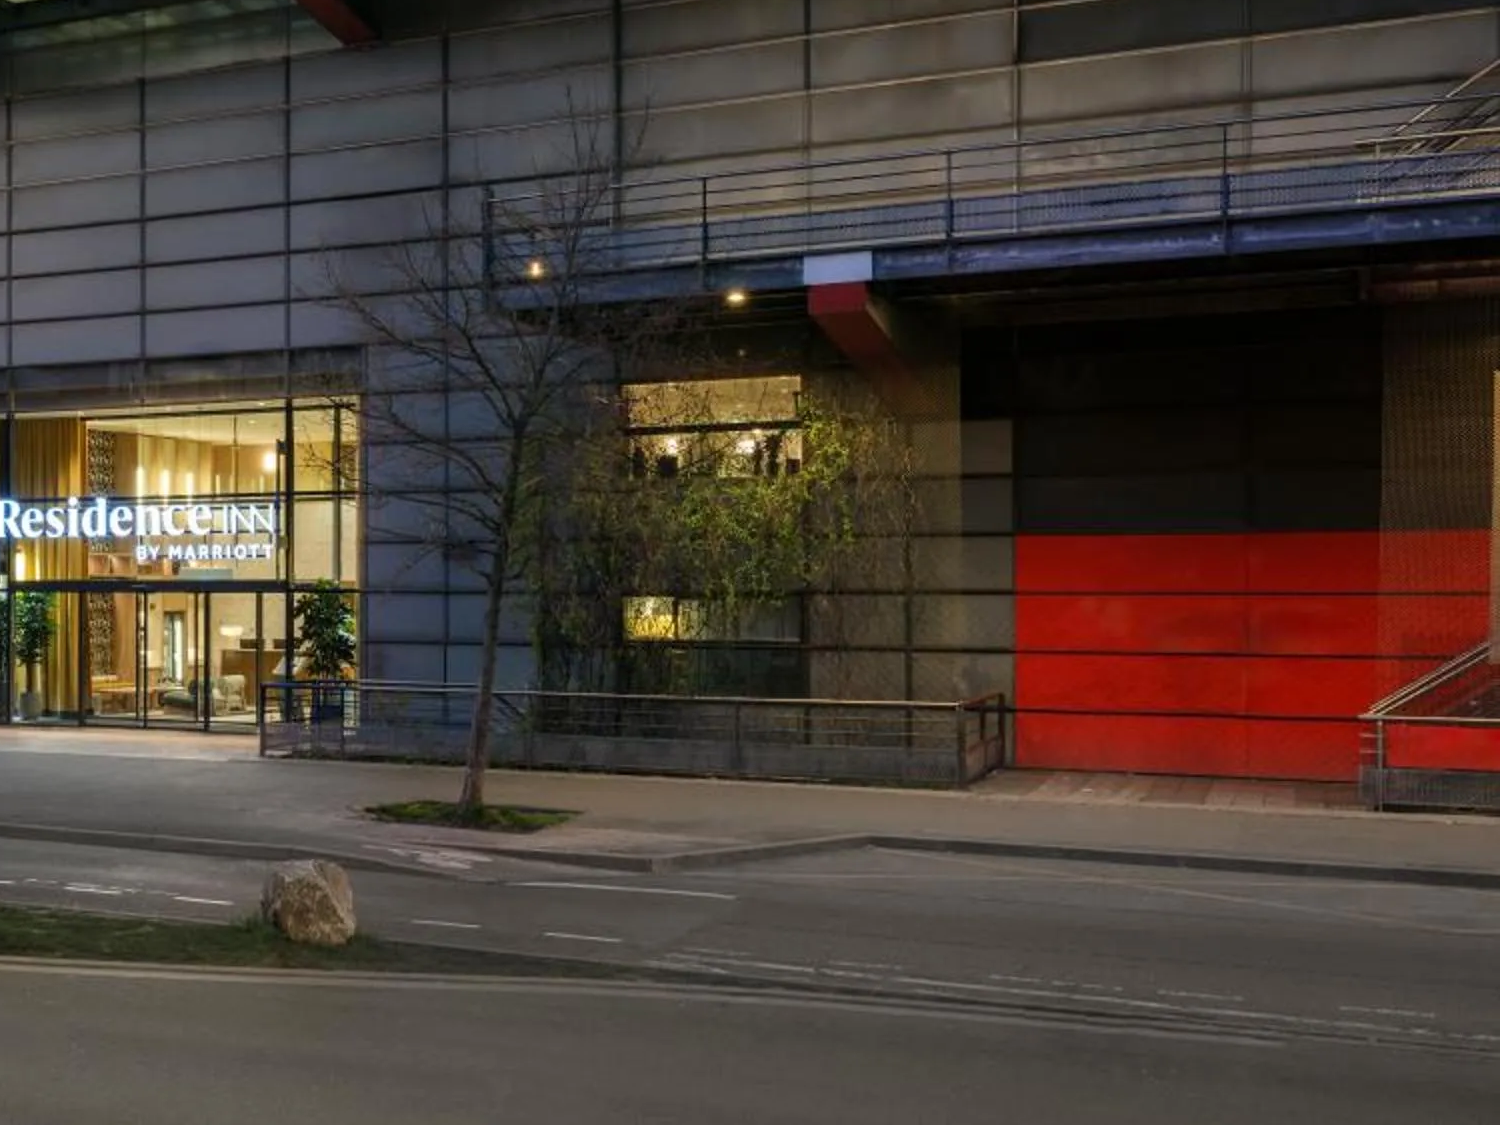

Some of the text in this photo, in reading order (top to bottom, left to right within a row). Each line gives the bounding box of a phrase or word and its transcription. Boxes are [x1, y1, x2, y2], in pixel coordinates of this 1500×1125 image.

[222, 502, 275, 536] INN
[136, 542, 274, 561] BY MARRIOTT
